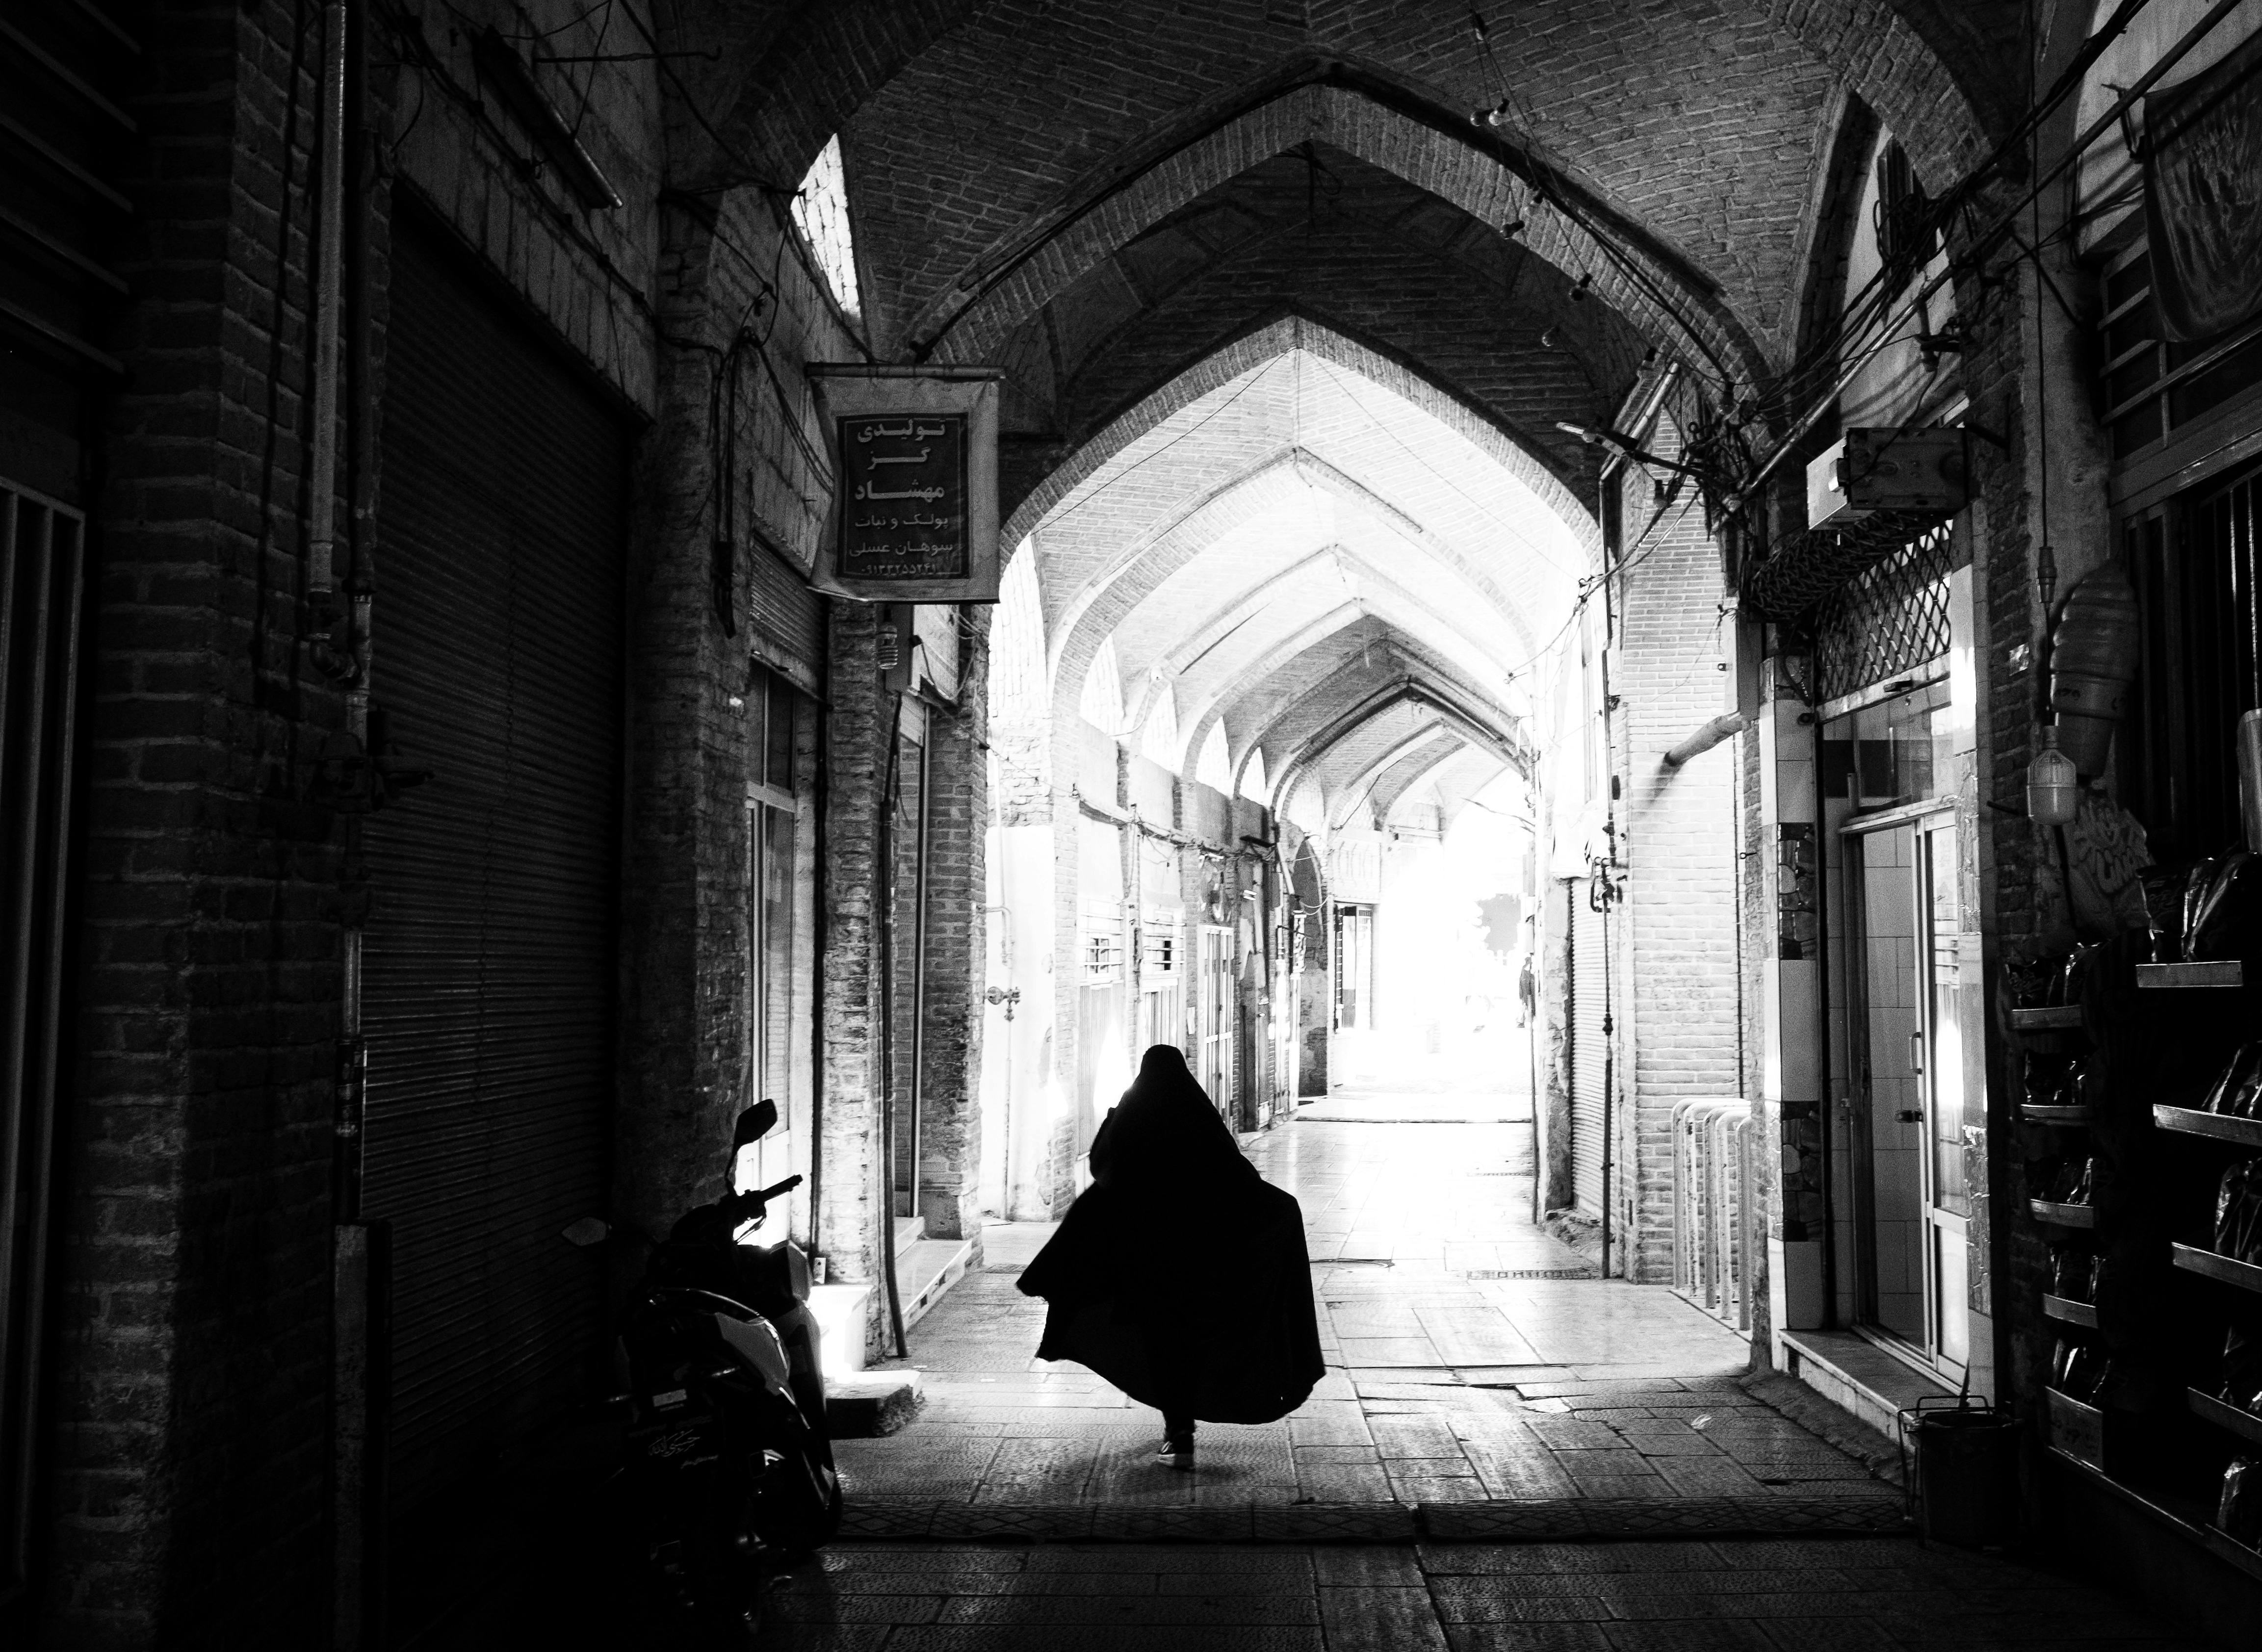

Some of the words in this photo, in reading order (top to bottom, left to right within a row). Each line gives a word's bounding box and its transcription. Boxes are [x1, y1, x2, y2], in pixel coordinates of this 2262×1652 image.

[857, 419, 946, 443] تولیدی
[867, 446, 932, 470] گز
[854, 479, 946, 503] مهشاد
[854, 515, 887, 528] نبات
[890, 517, 898, 530] و
[849, 542, 890, 558] عسلی
[895, 541, 954, 556] سوهان
